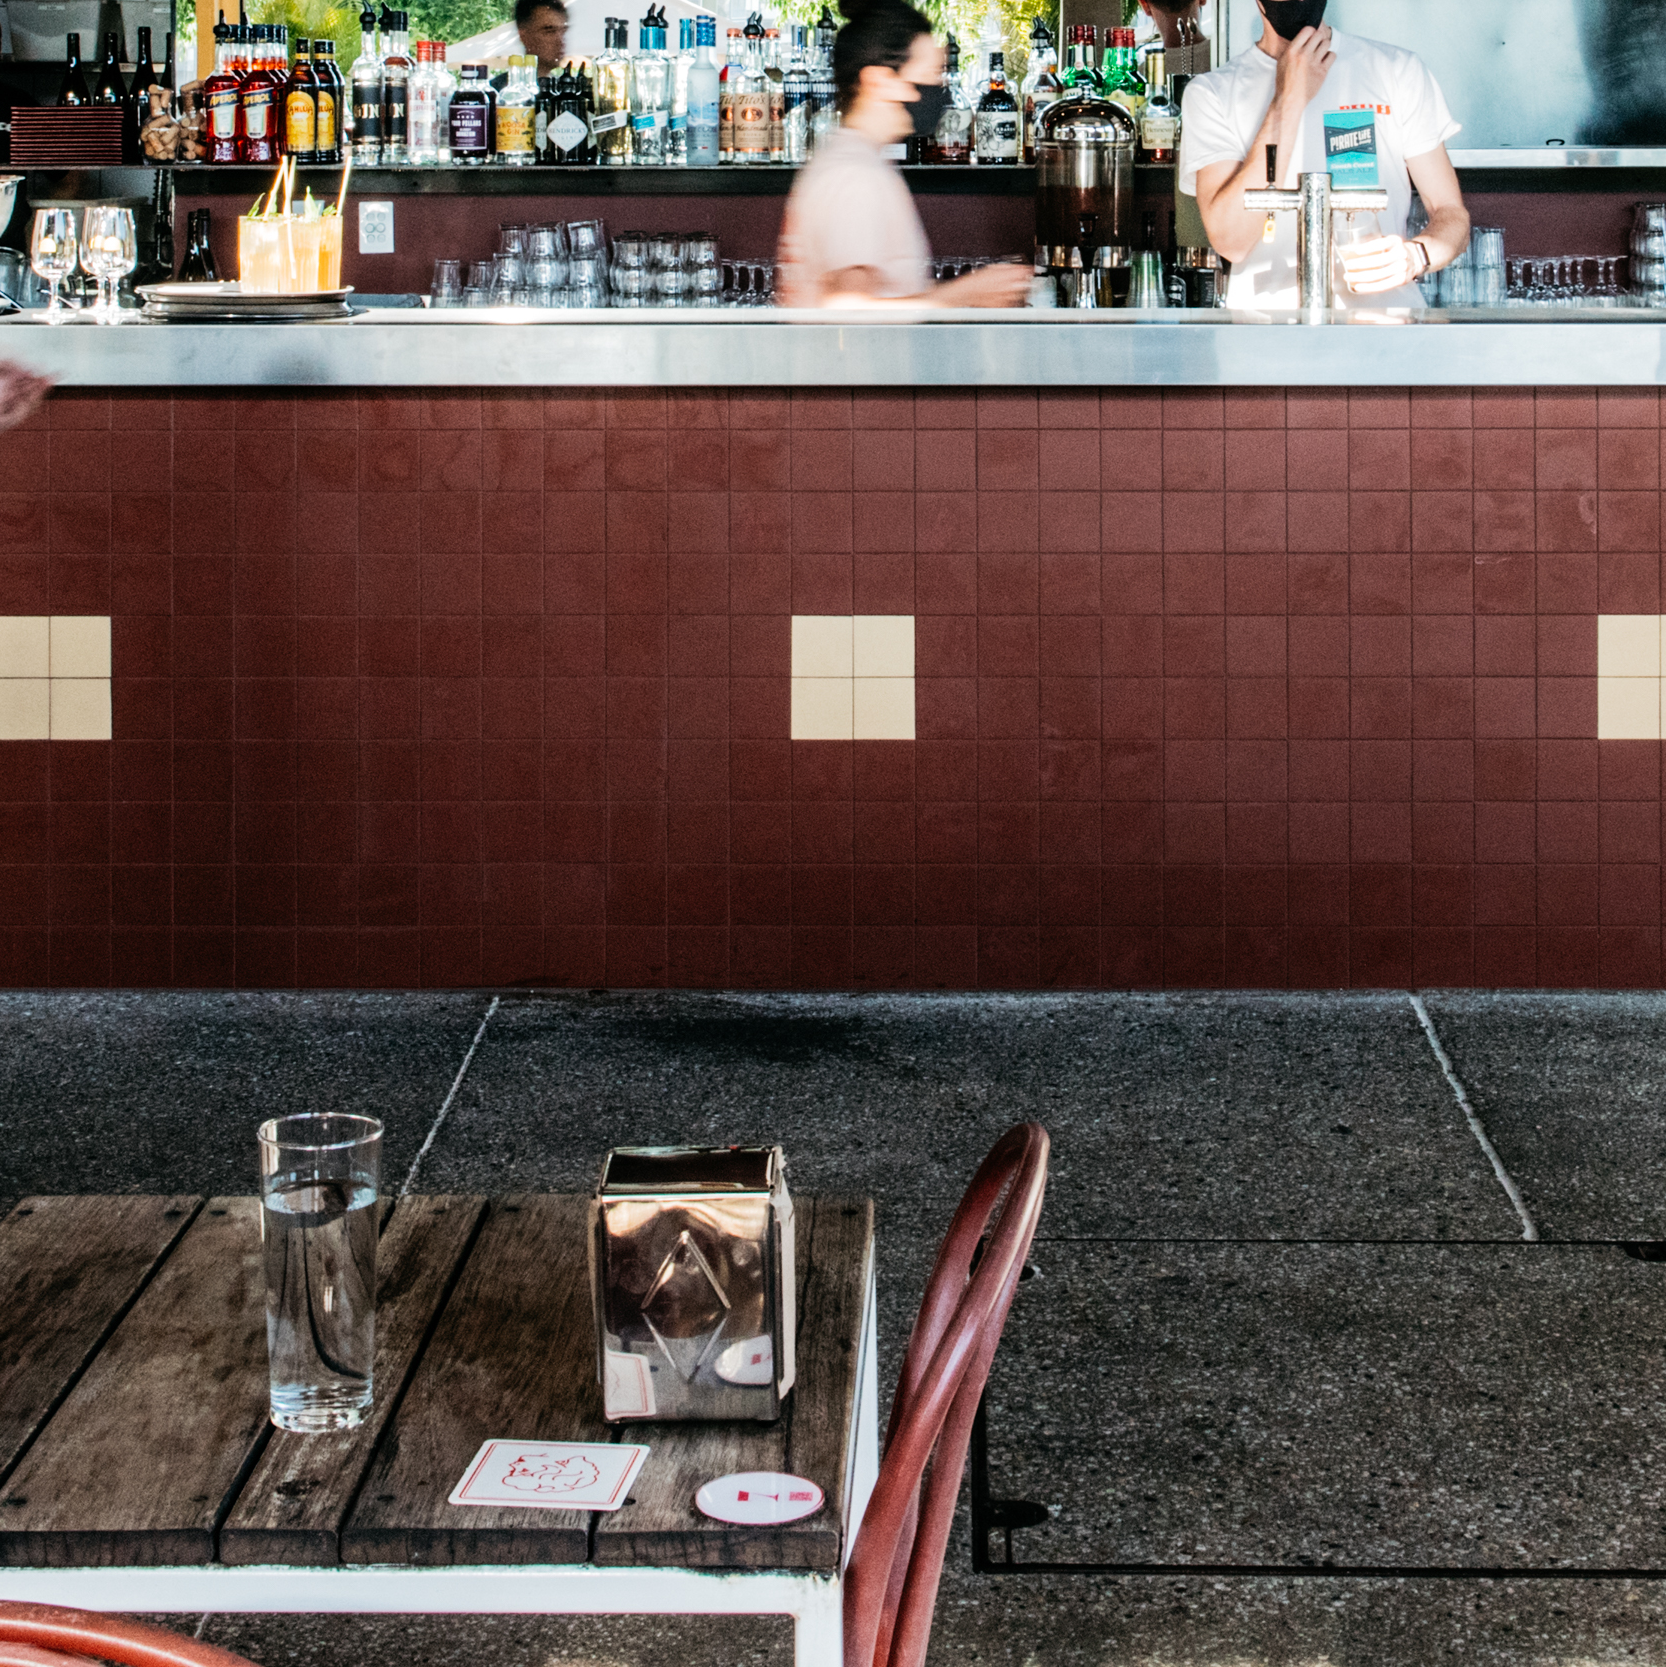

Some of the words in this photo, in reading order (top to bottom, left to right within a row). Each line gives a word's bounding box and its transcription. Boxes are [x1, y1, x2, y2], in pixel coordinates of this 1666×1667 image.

[210, 91, 238, 106] APEROL
[242, 91, 271, 106] APEROL
[738, 94, 766, 106] Tito's
[353, 103, 380, 119] GIN
